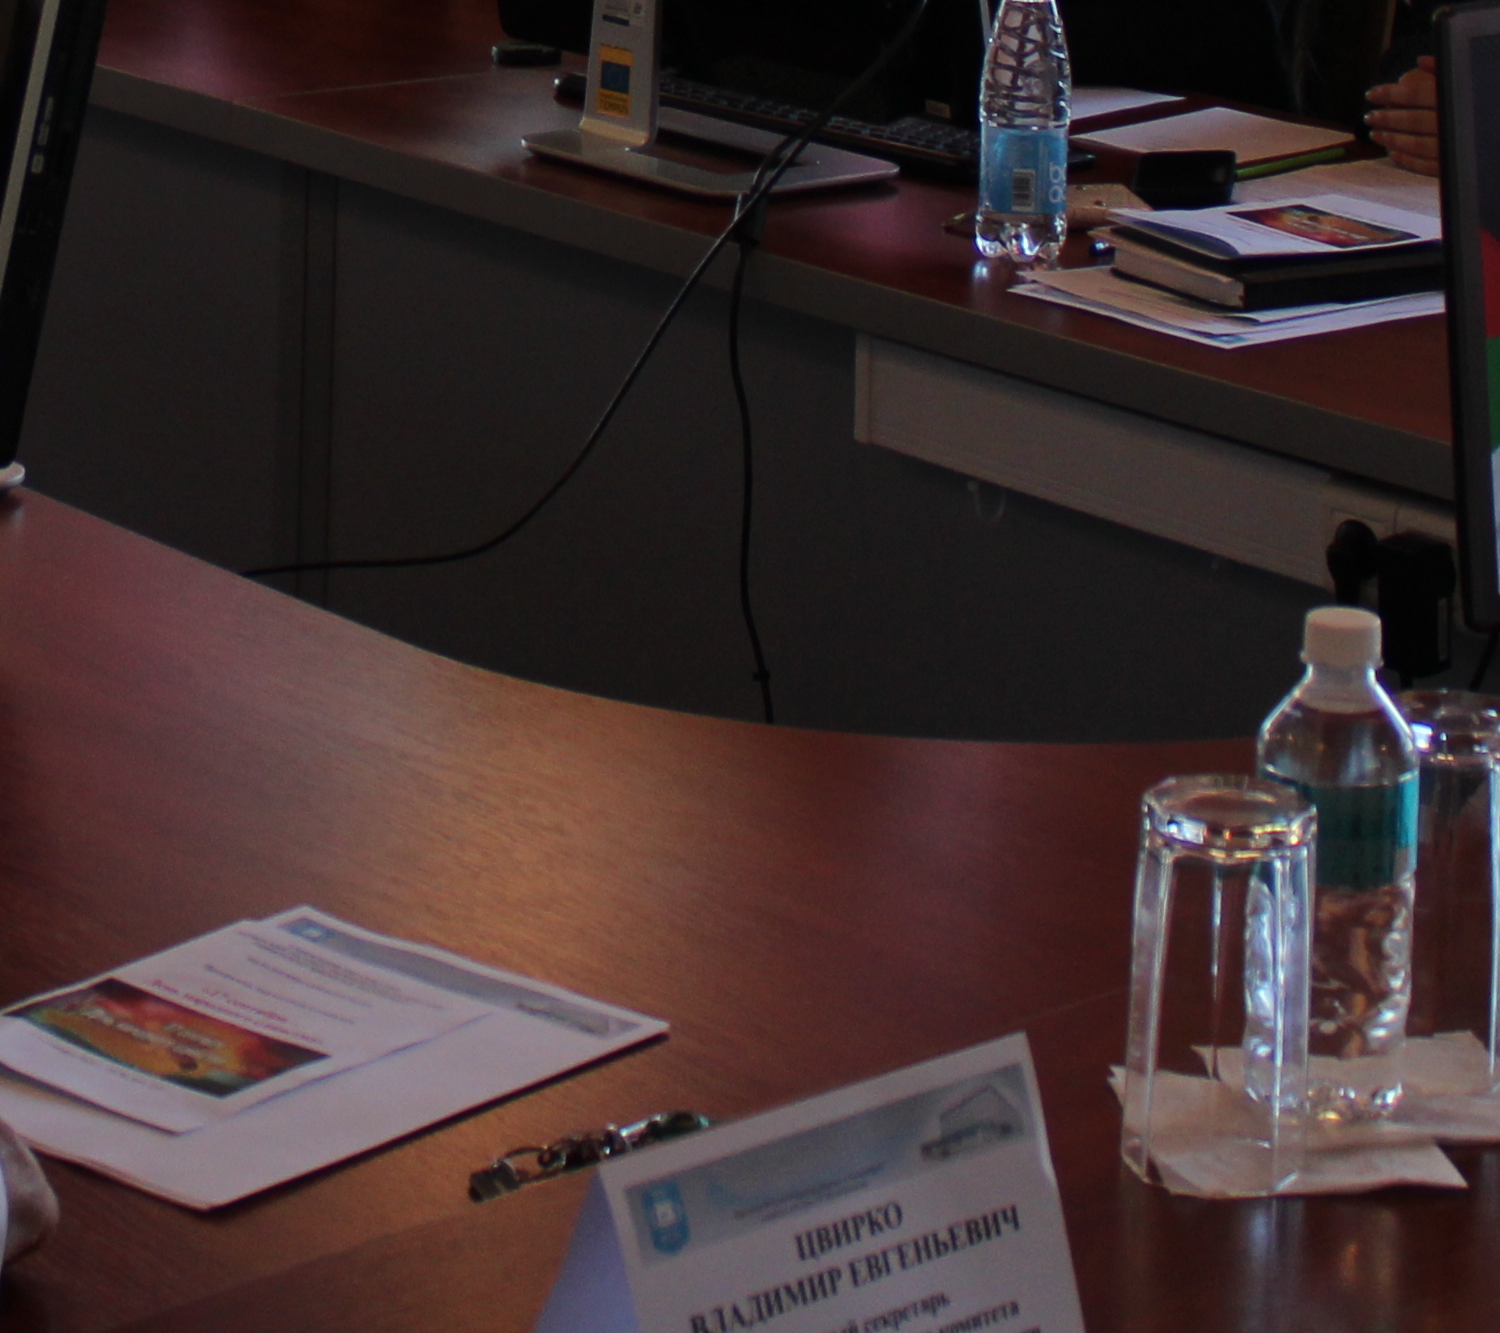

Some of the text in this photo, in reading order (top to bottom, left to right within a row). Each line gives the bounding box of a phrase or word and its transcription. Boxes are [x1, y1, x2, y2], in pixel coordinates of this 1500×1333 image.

[690, 1206, 1019, 1333] ВЛАДИМИР ЕВГЕНЬЕВИЧ
[795, 1203, 903, 1260] ЦВИРКО
